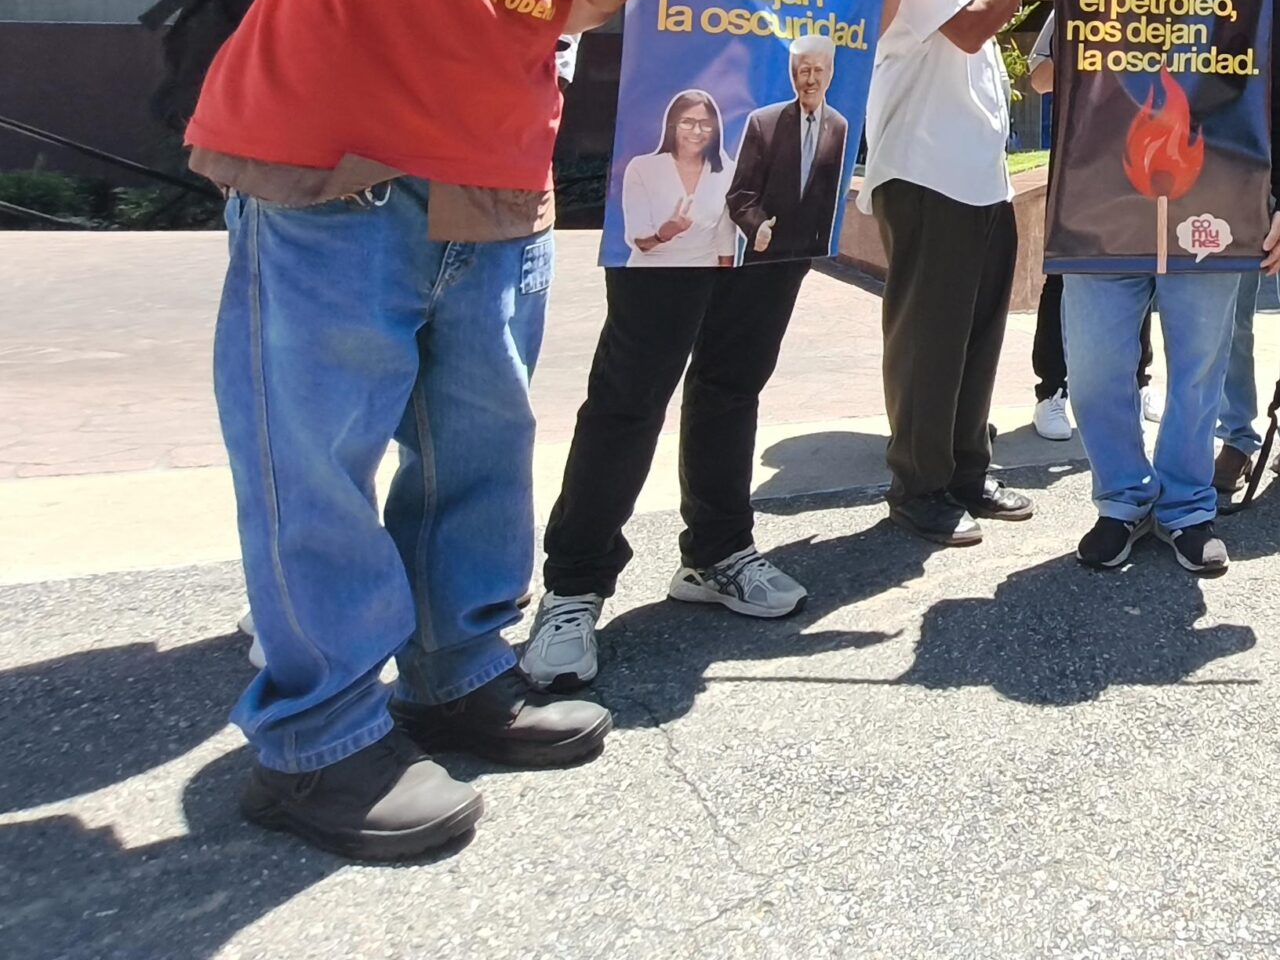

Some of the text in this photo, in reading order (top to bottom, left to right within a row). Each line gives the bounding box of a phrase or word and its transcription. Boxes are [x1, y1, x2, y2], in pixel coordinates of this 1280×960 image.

[701, 5, 868, 51] oscuridad.
[1067, 16, 1207, 50] nos dejan
[1077, 42, 1259, 75] la oscuridad.
